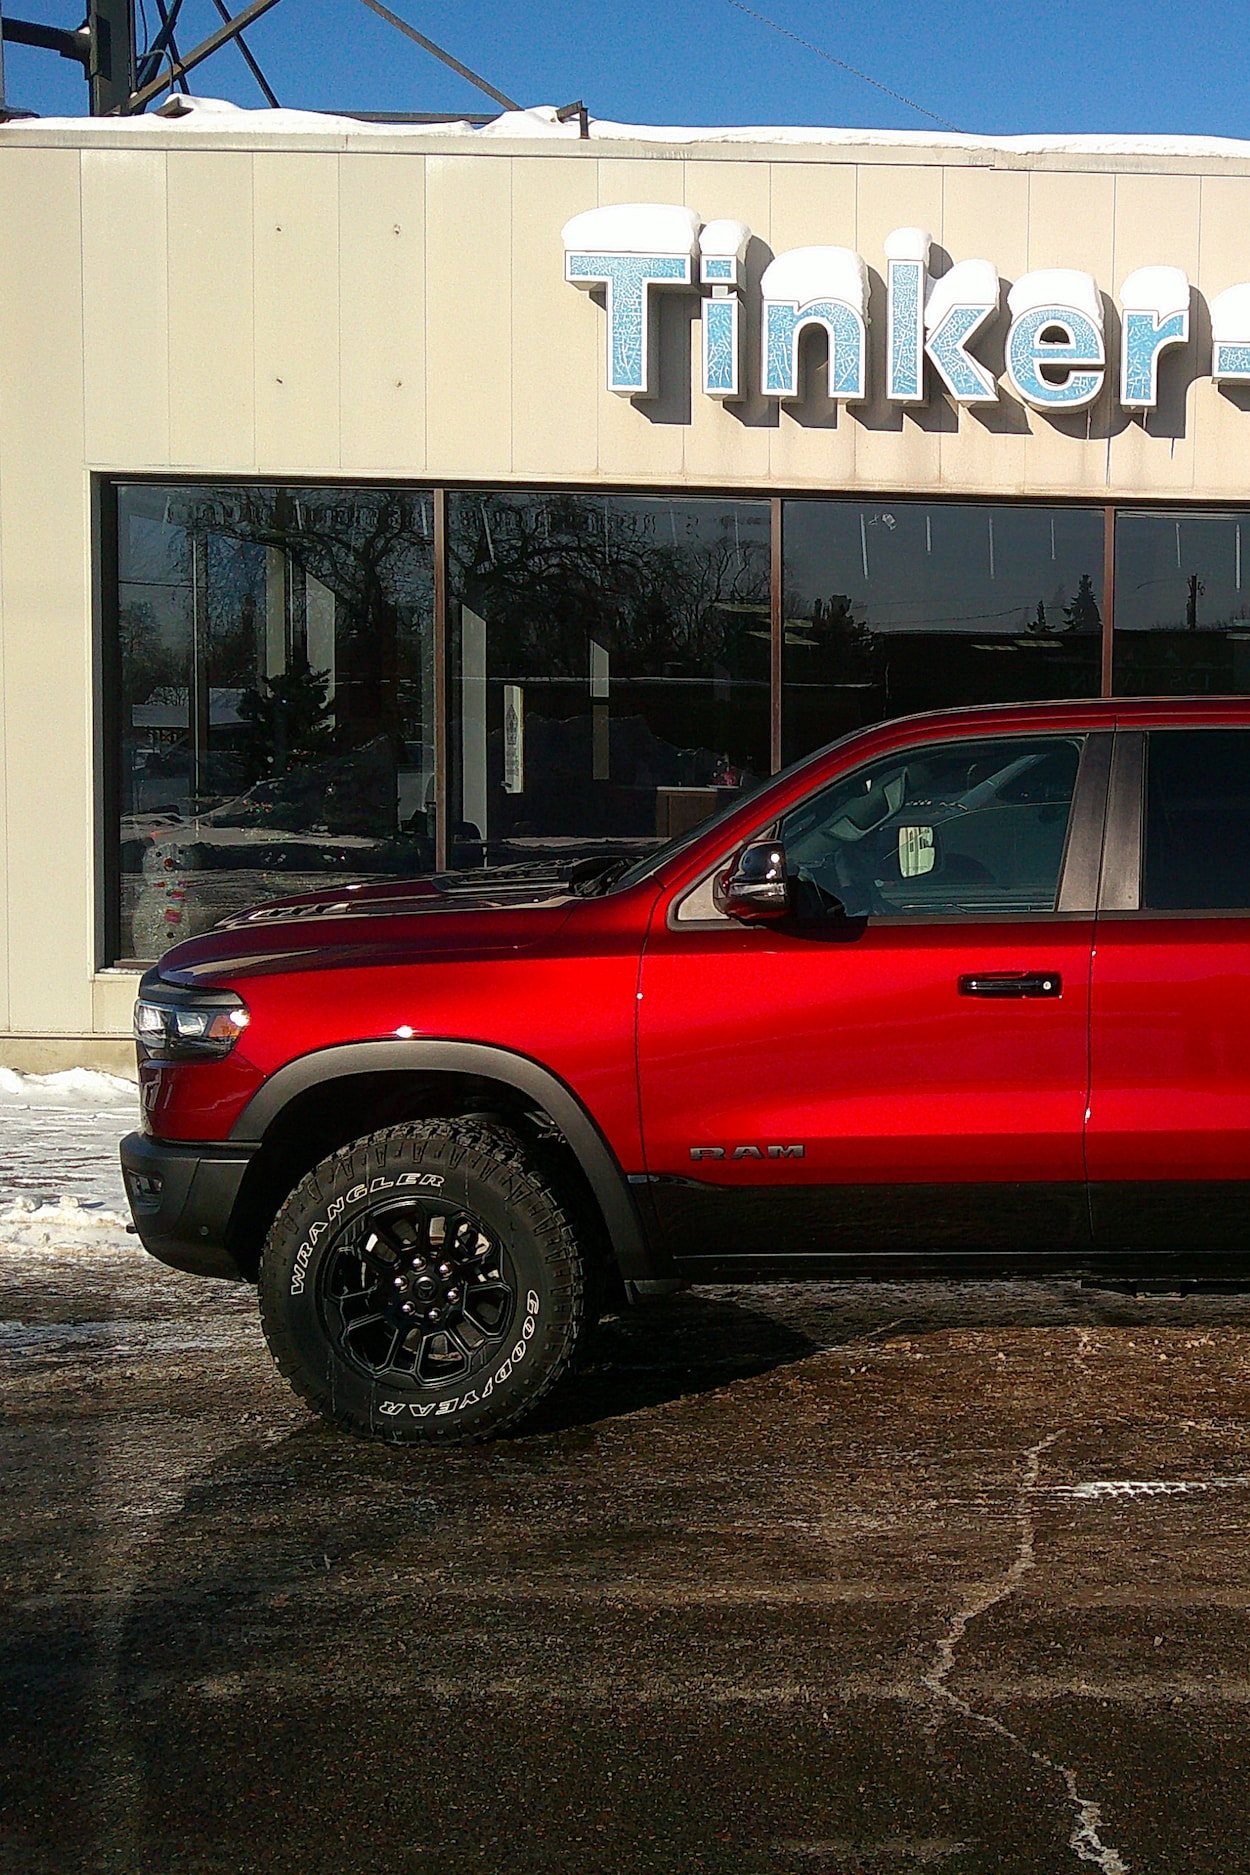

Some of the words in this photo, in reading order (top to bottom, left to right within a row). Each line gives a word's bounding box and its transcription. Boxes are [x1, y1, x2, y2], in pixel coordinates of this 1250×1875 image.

[689, 1145, 805, 1160] RAM
[290, 1172, 445, 1295] WRANGLER
[378, 1290, 539, 1417] GOODYEAR
